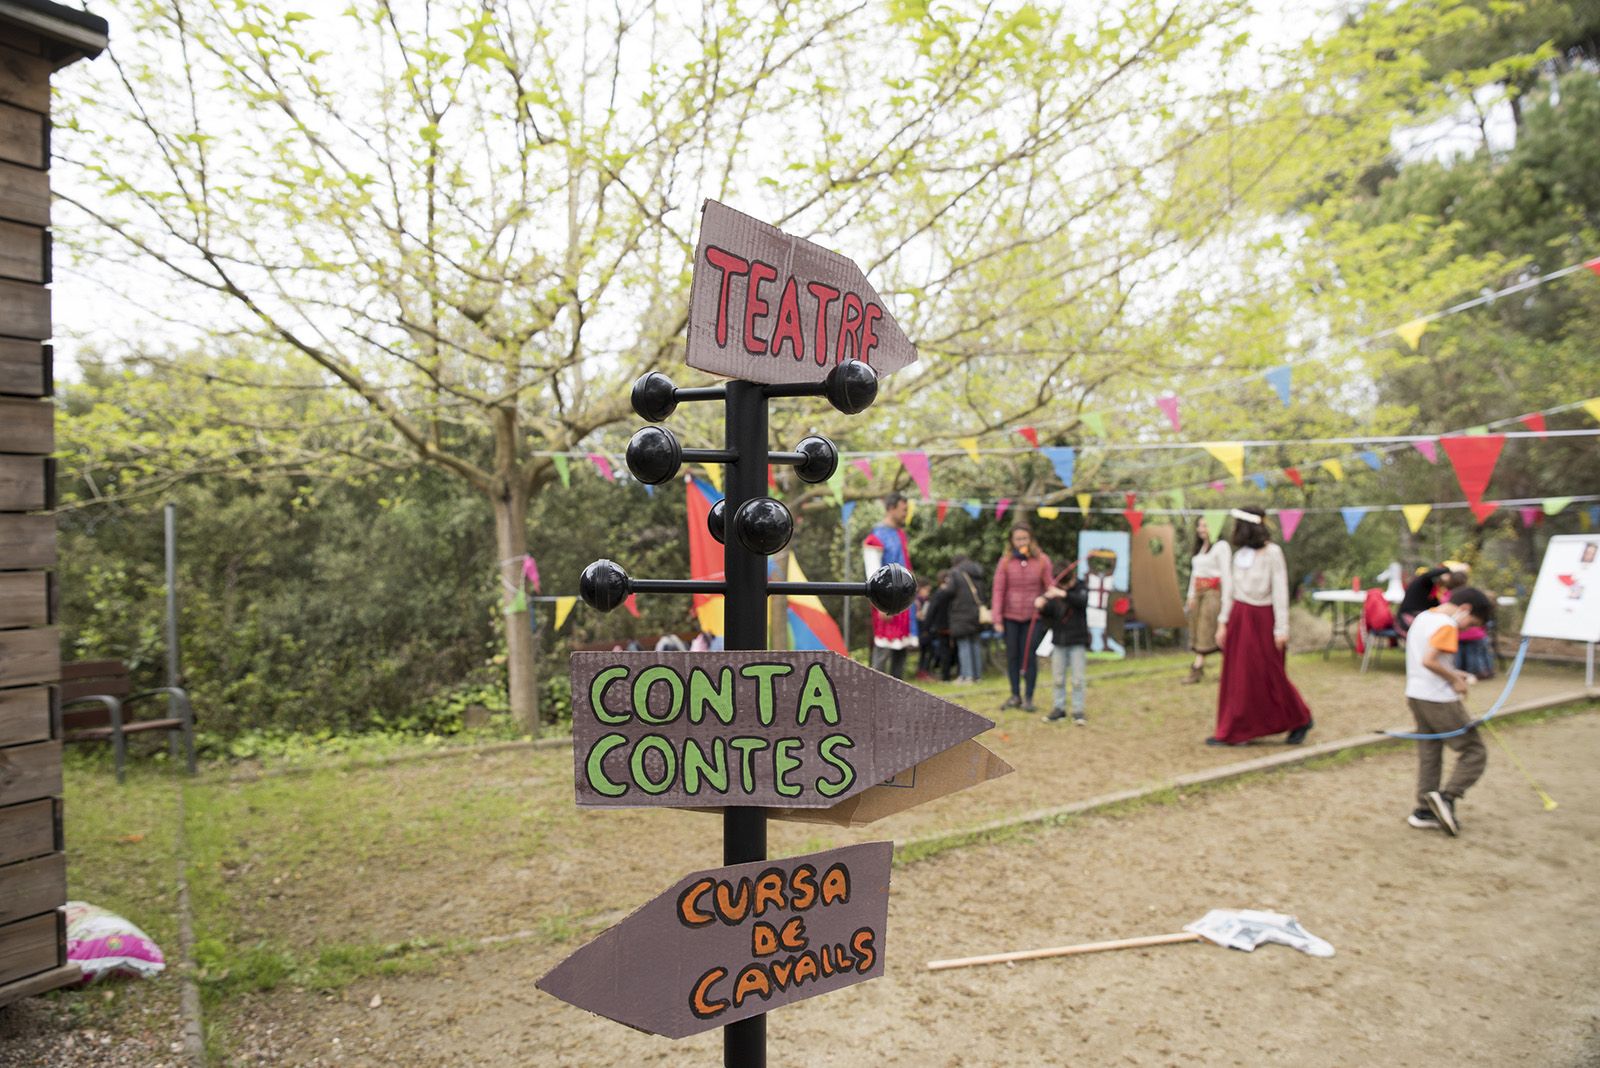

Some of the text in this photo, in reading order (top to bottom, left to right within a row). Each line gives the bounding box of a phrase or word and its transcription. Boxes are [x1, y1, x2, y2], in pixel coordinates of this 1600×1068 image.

[705, 245, 883, 369] TEATRE
[590, 663, 840, 726] CONTA
[586, 733, 857, 797] CONTES
[677, 863, 850, 928] CURSA
[753, 916, 807, 957] DE
[688, 927, 875, 1019] CAVALLS
